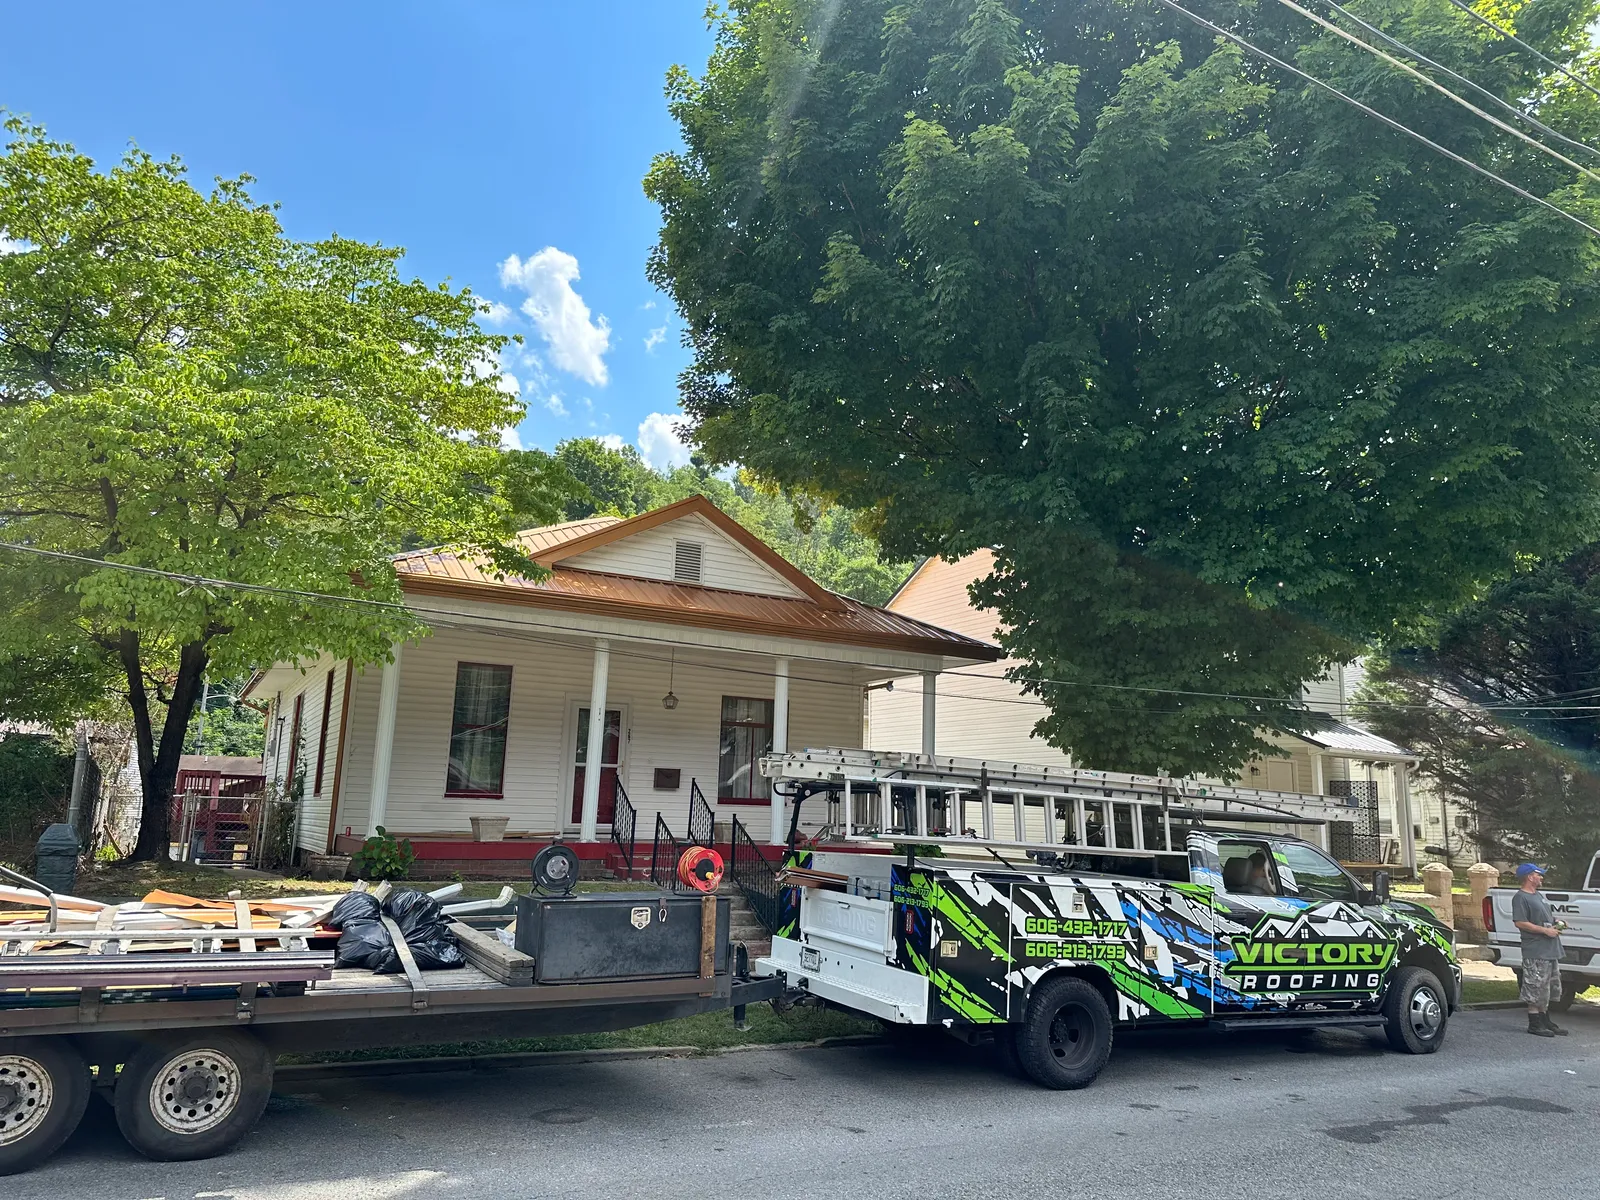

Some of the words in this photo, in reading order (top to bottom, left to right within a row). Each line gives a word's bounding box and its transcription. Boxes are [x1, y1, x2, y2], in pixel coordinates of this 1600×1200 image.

[1550, 904, 1580, 914] MC
[1025, 918, 1128, 936] 606-432-1717
[1025, 942, 1126, 960] 606-213-1793
[1234, 942, 1396, 965] VICTORY
[1243, 973, 1380, 990] ROOFING
